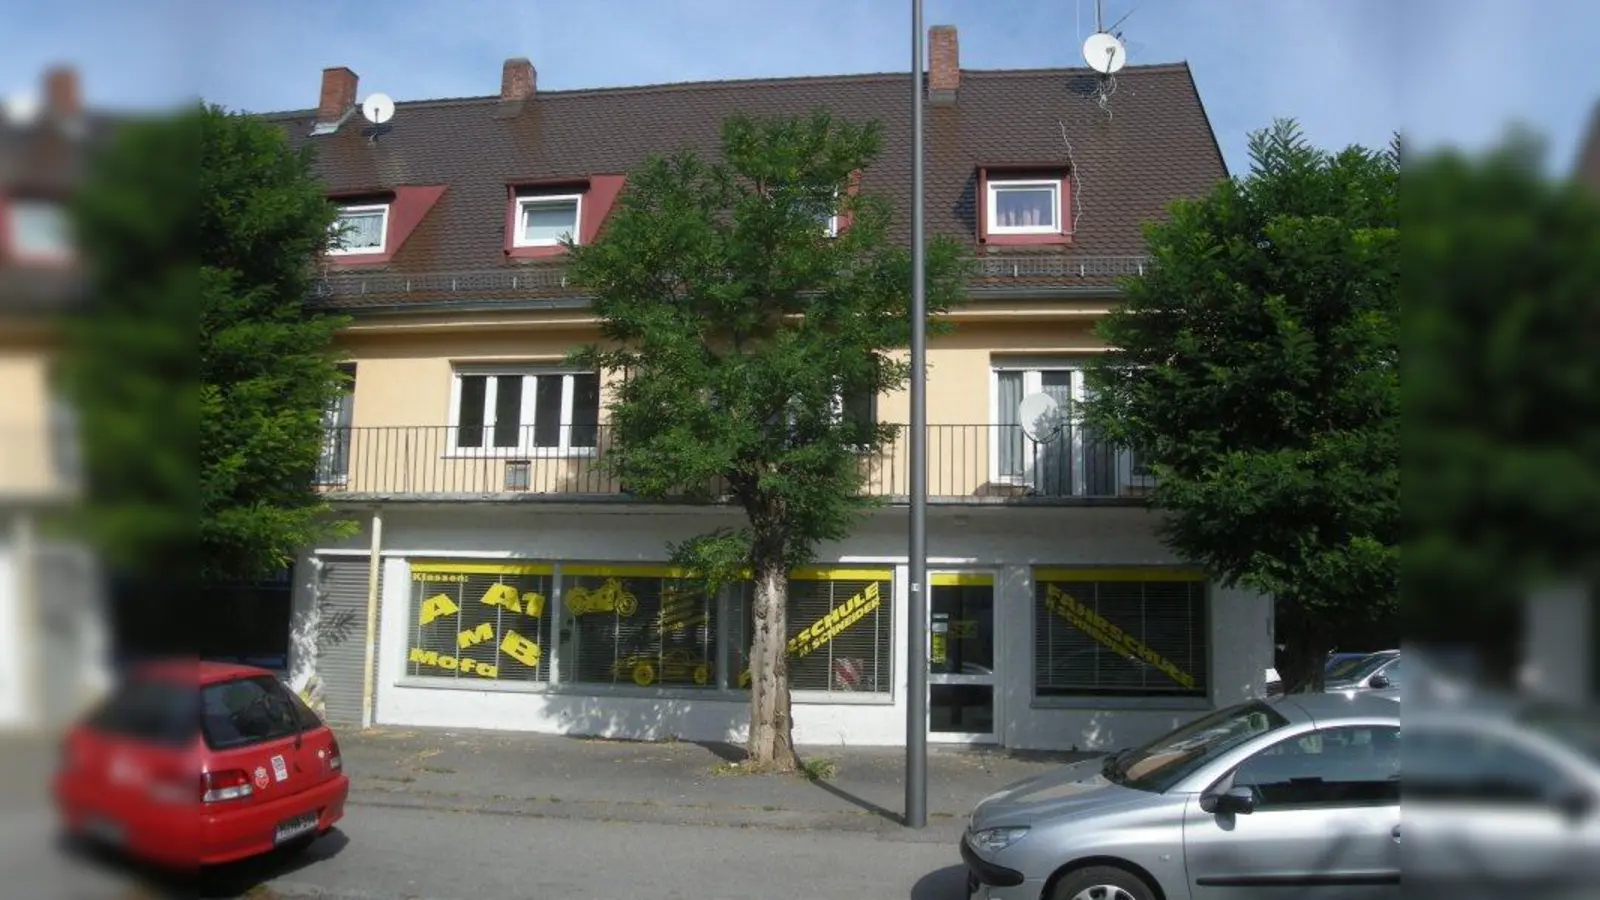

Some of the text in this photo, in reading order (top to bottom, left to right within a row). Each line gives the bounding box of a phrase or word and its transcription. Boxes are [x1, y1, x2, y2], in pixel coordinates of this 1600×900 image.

[420, 593, 459, 626] A
[480, 582, 546, 618] A1
[457, 622, 494, 649] M
[500, 629, 541, 667] B
[409, 647, 498, 678] Mofa
